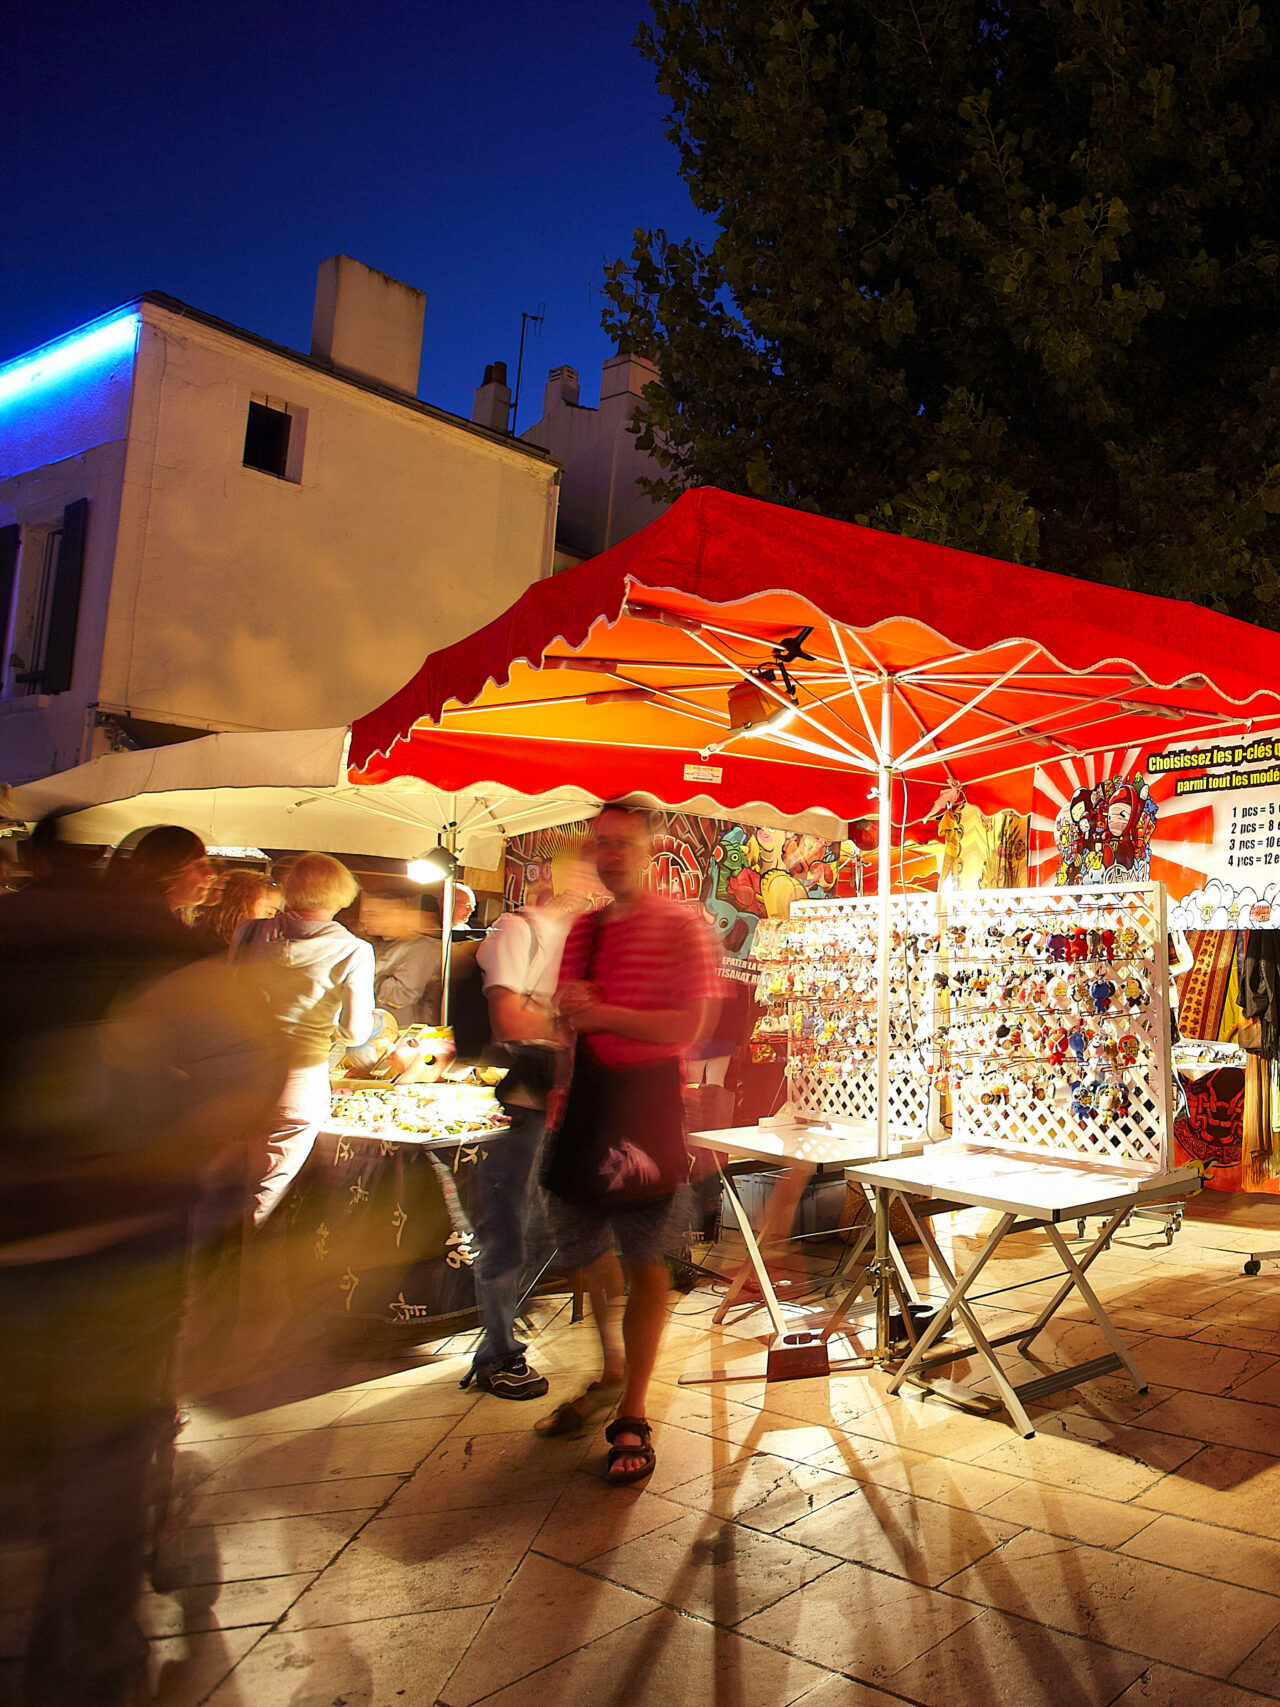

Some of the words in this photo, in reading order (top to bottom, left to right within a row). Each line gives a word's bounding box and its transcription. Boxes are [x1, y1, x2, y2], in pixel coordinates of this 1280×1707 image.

[1149, 752, 1211, 771] Choisissez
[1213, 749, 1232, 764] les
[1234, 743, 1272, 762] p-clés
[1177, 777, 1206, 793] parmi
[1208, 775, 1230, 788] tout
[1232, 773, 1248, 787] les
[1232, 806, 1237, 818] 1
[1269, 803, 1275, 815] 5
[1231, 822, 1237, 834] 2
[1268, 819, 1274, 831] 8
[1229, 839, 1235, 850] 3
[1265, 836, 1275, 848] 10
[1228, 855, 1234, 866] 4
[1264, 852, 1273, 865] 12
[722, 957, 747, 969] EPATER
[748, 962, 756, 971] LA
